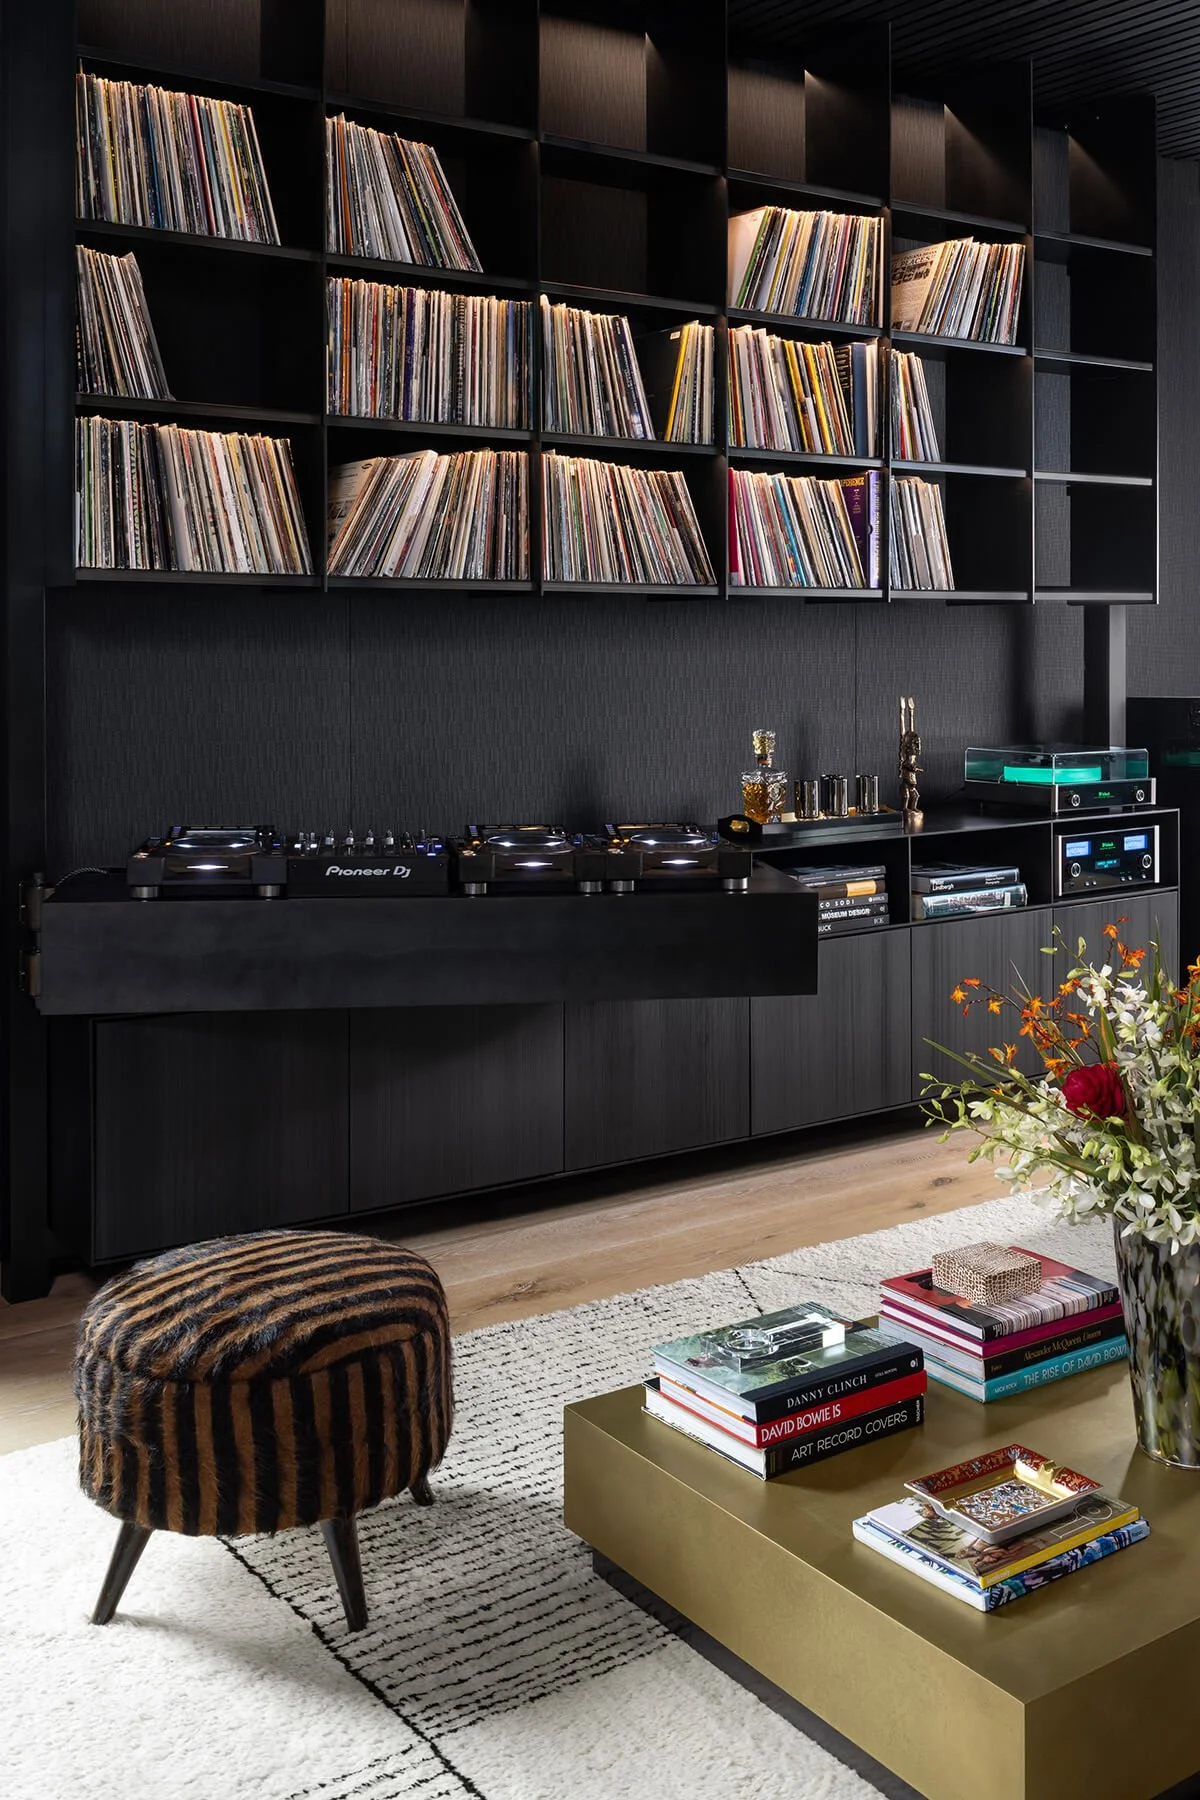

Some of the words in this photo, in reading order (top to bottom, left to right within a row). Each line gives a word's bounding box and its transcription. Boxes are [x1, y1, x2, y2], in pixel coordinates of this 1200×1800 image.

[325, 865, 390, 876] Pioneer
[932, 882, 954, 891] Lindbergh
[821, 910, 848, 920] MUSEUM
[835, 899, 855, 907] SODI
[1024, 1346, 1052, 1361] Alexander
[1051, 1336, 1082, 1354] McQueen
[1024, 1372, 1039, 1385] THE
[1042, 1367, 1060, 1380] RISE
[1062, 1360, 1075, 1374] OF
[1077, 1352, 1102, 1368] DAVID
[787, 1388, 824, 1408] DANNY
[827, 1374, 867, 1395] CLINCH
[761, 1421, 795, 1442] DAVID
[797, 1408, 831, 1428] BOWIE
[832, 1403, 841, 1419] IS
[791, 1442, 814, 1462] ART
[817, 1426, 862, 1453] RECORD
[865, 1410, 908, 1434] COVERS
